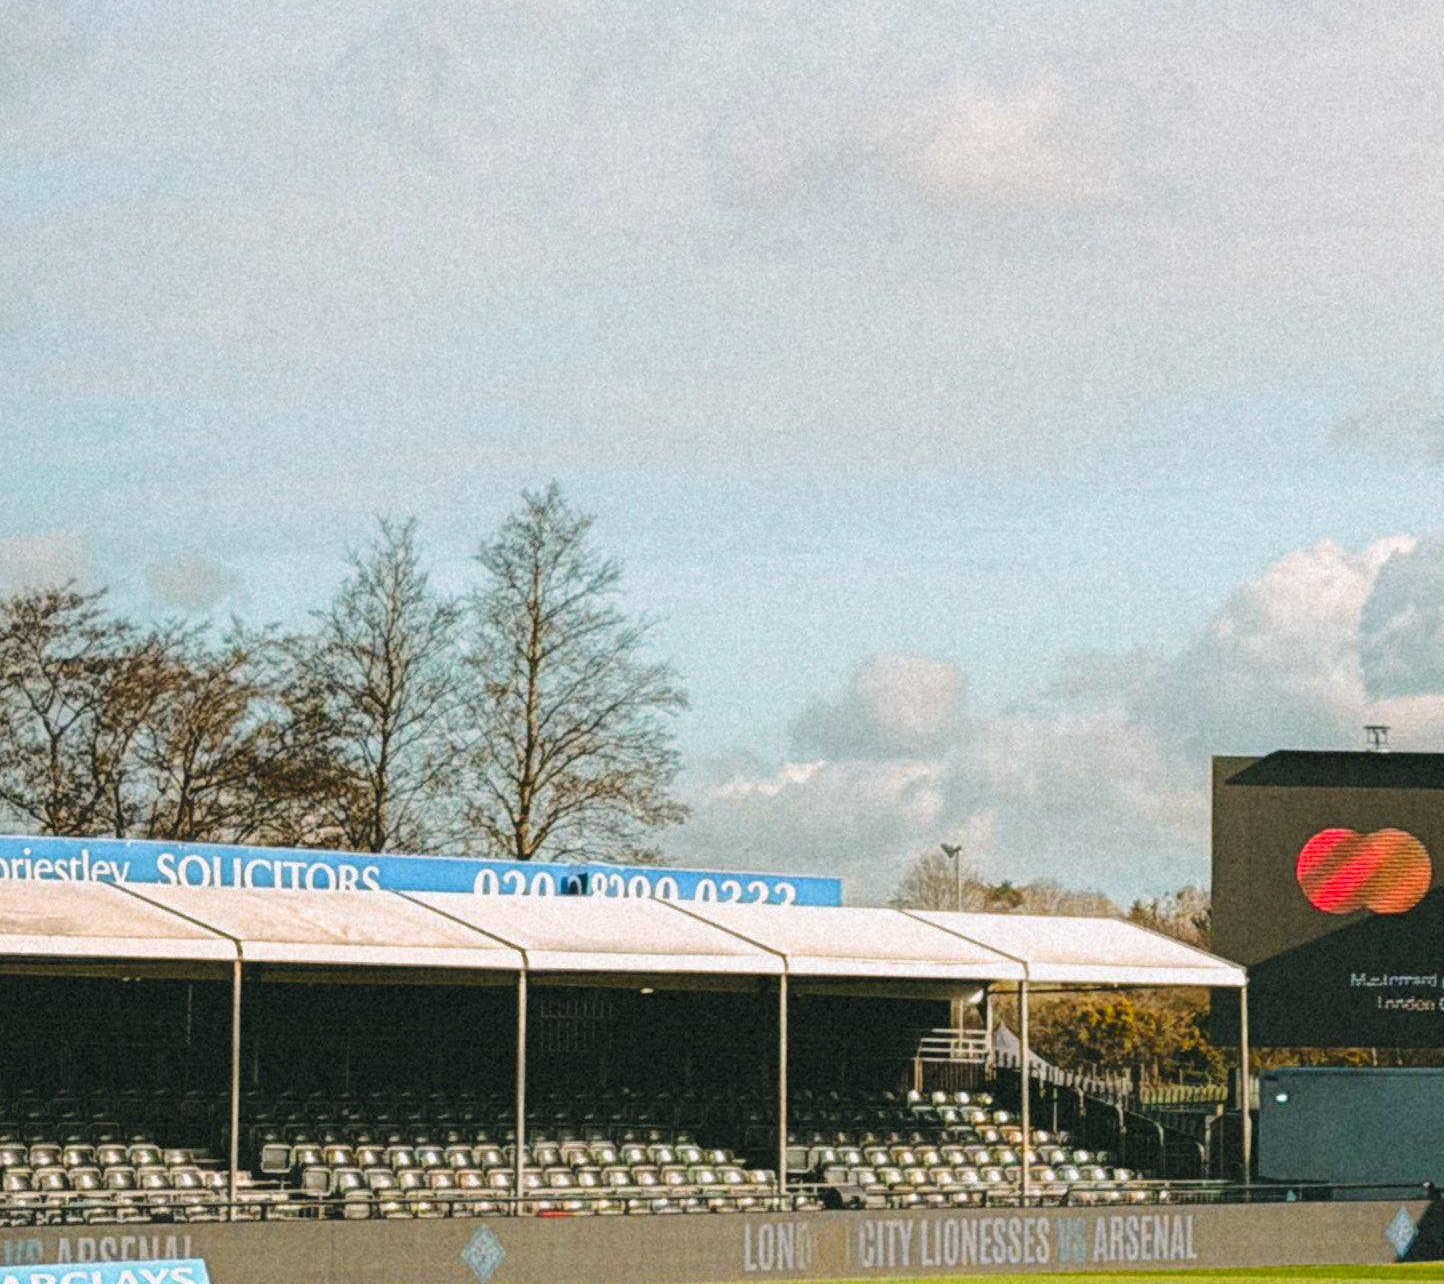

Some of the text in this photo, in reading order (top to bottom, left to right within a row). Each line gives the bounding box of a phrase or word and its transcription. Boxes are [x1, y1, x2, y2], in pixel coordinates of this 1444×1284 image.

[859, 1219, 914, 1268] CITY
[921, 1216, 1050, 1266] LIONESSES
[1093, 1214, 1198, 1262] ARSENAL
